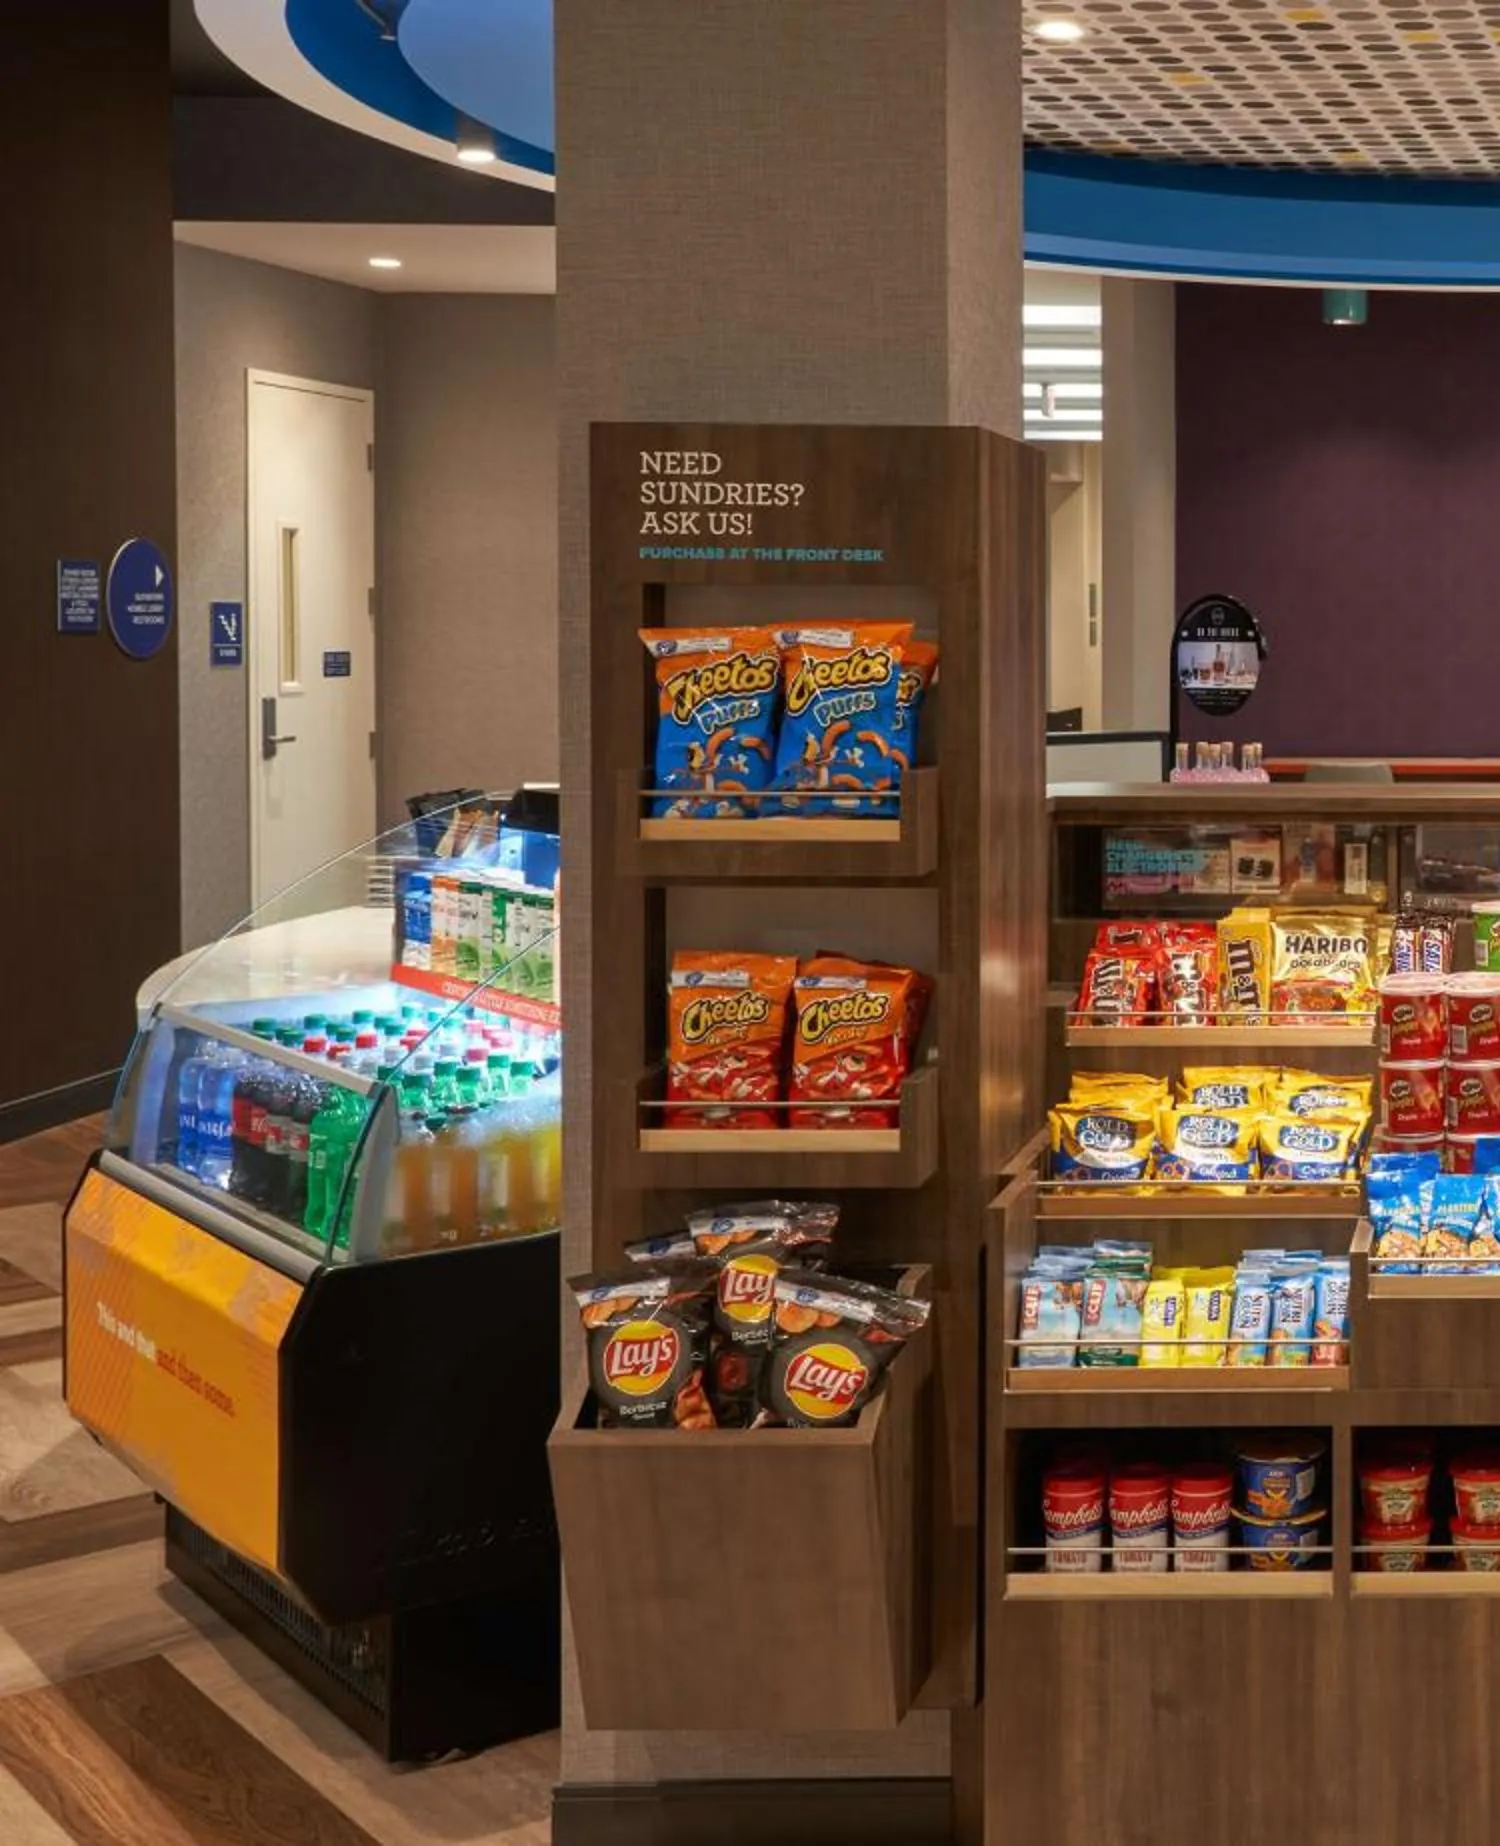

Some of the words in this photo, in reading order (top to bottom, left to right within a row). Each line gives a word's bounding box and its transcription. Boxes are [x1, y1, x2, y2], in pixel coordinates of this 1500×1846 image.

[639, 451, 722, 475] NEED
[639, 481, 805, 507] SUNDRIES?
[639, 511, 701, 535] ASK
[707, 512, 754, 536] US!
[639, 547, 726, 561] PURCHASE
[729, 548, 748, 560] AT
[752, 548, 783, 561] THE
[786, 548, 838, 561] FRONT
[842, 549, 885, 562] DESK
[664, 654, 780, 725] Cheetos
[786, 649, 893, 716] Cheetos
[1285, 935, 1368, 954] HARIBO
[682, 990, 770, 1043] Cheetos
[801, 990, 891, 1044] Cheetos
[1087, 1117, 1129, 1131] ROLD
[723, 1269, 775, 1304] Lay
[609, 1334, 673, 1376] Lay's
[789, 1355, 864, 1401] Lay's
